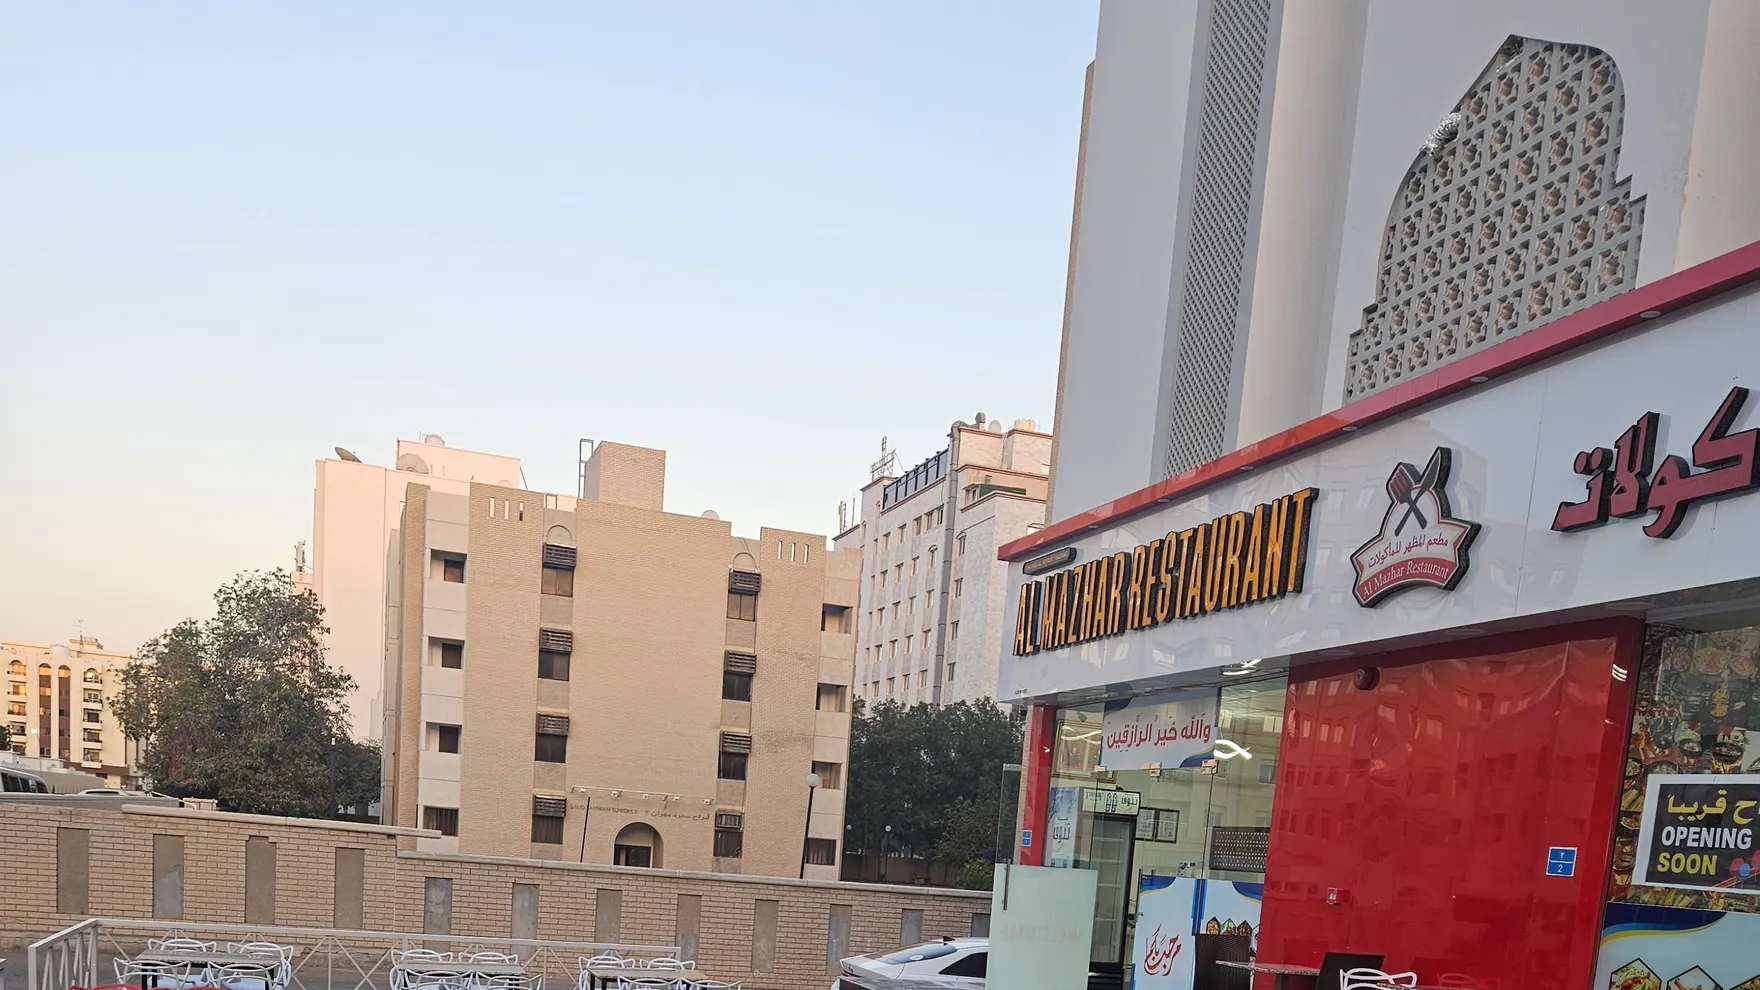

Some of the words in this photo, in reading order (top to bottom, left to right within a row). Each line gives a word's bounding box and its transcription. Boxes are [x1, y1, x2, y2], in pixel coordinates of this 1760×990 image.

[1403, 534, 1426, 554] المظهر
[1427, 532, 1449, 552] مطعم
[1013, 580, 1041, 656] AL
[1040, 552, 1130, 650] MAZHAR
[1127, 488, 1319, 631] RESTAURANT
[1363, 582, 1374, 599] Al
[1374, 566, 1405, 591] Mazhar
[1406, 561, 1449, 579] Restaurant
[1661, 825, 1752, 850] OPENING
[1557, 864, 1564, 873] 2
[1657, 852, 1718, 876] SOON
